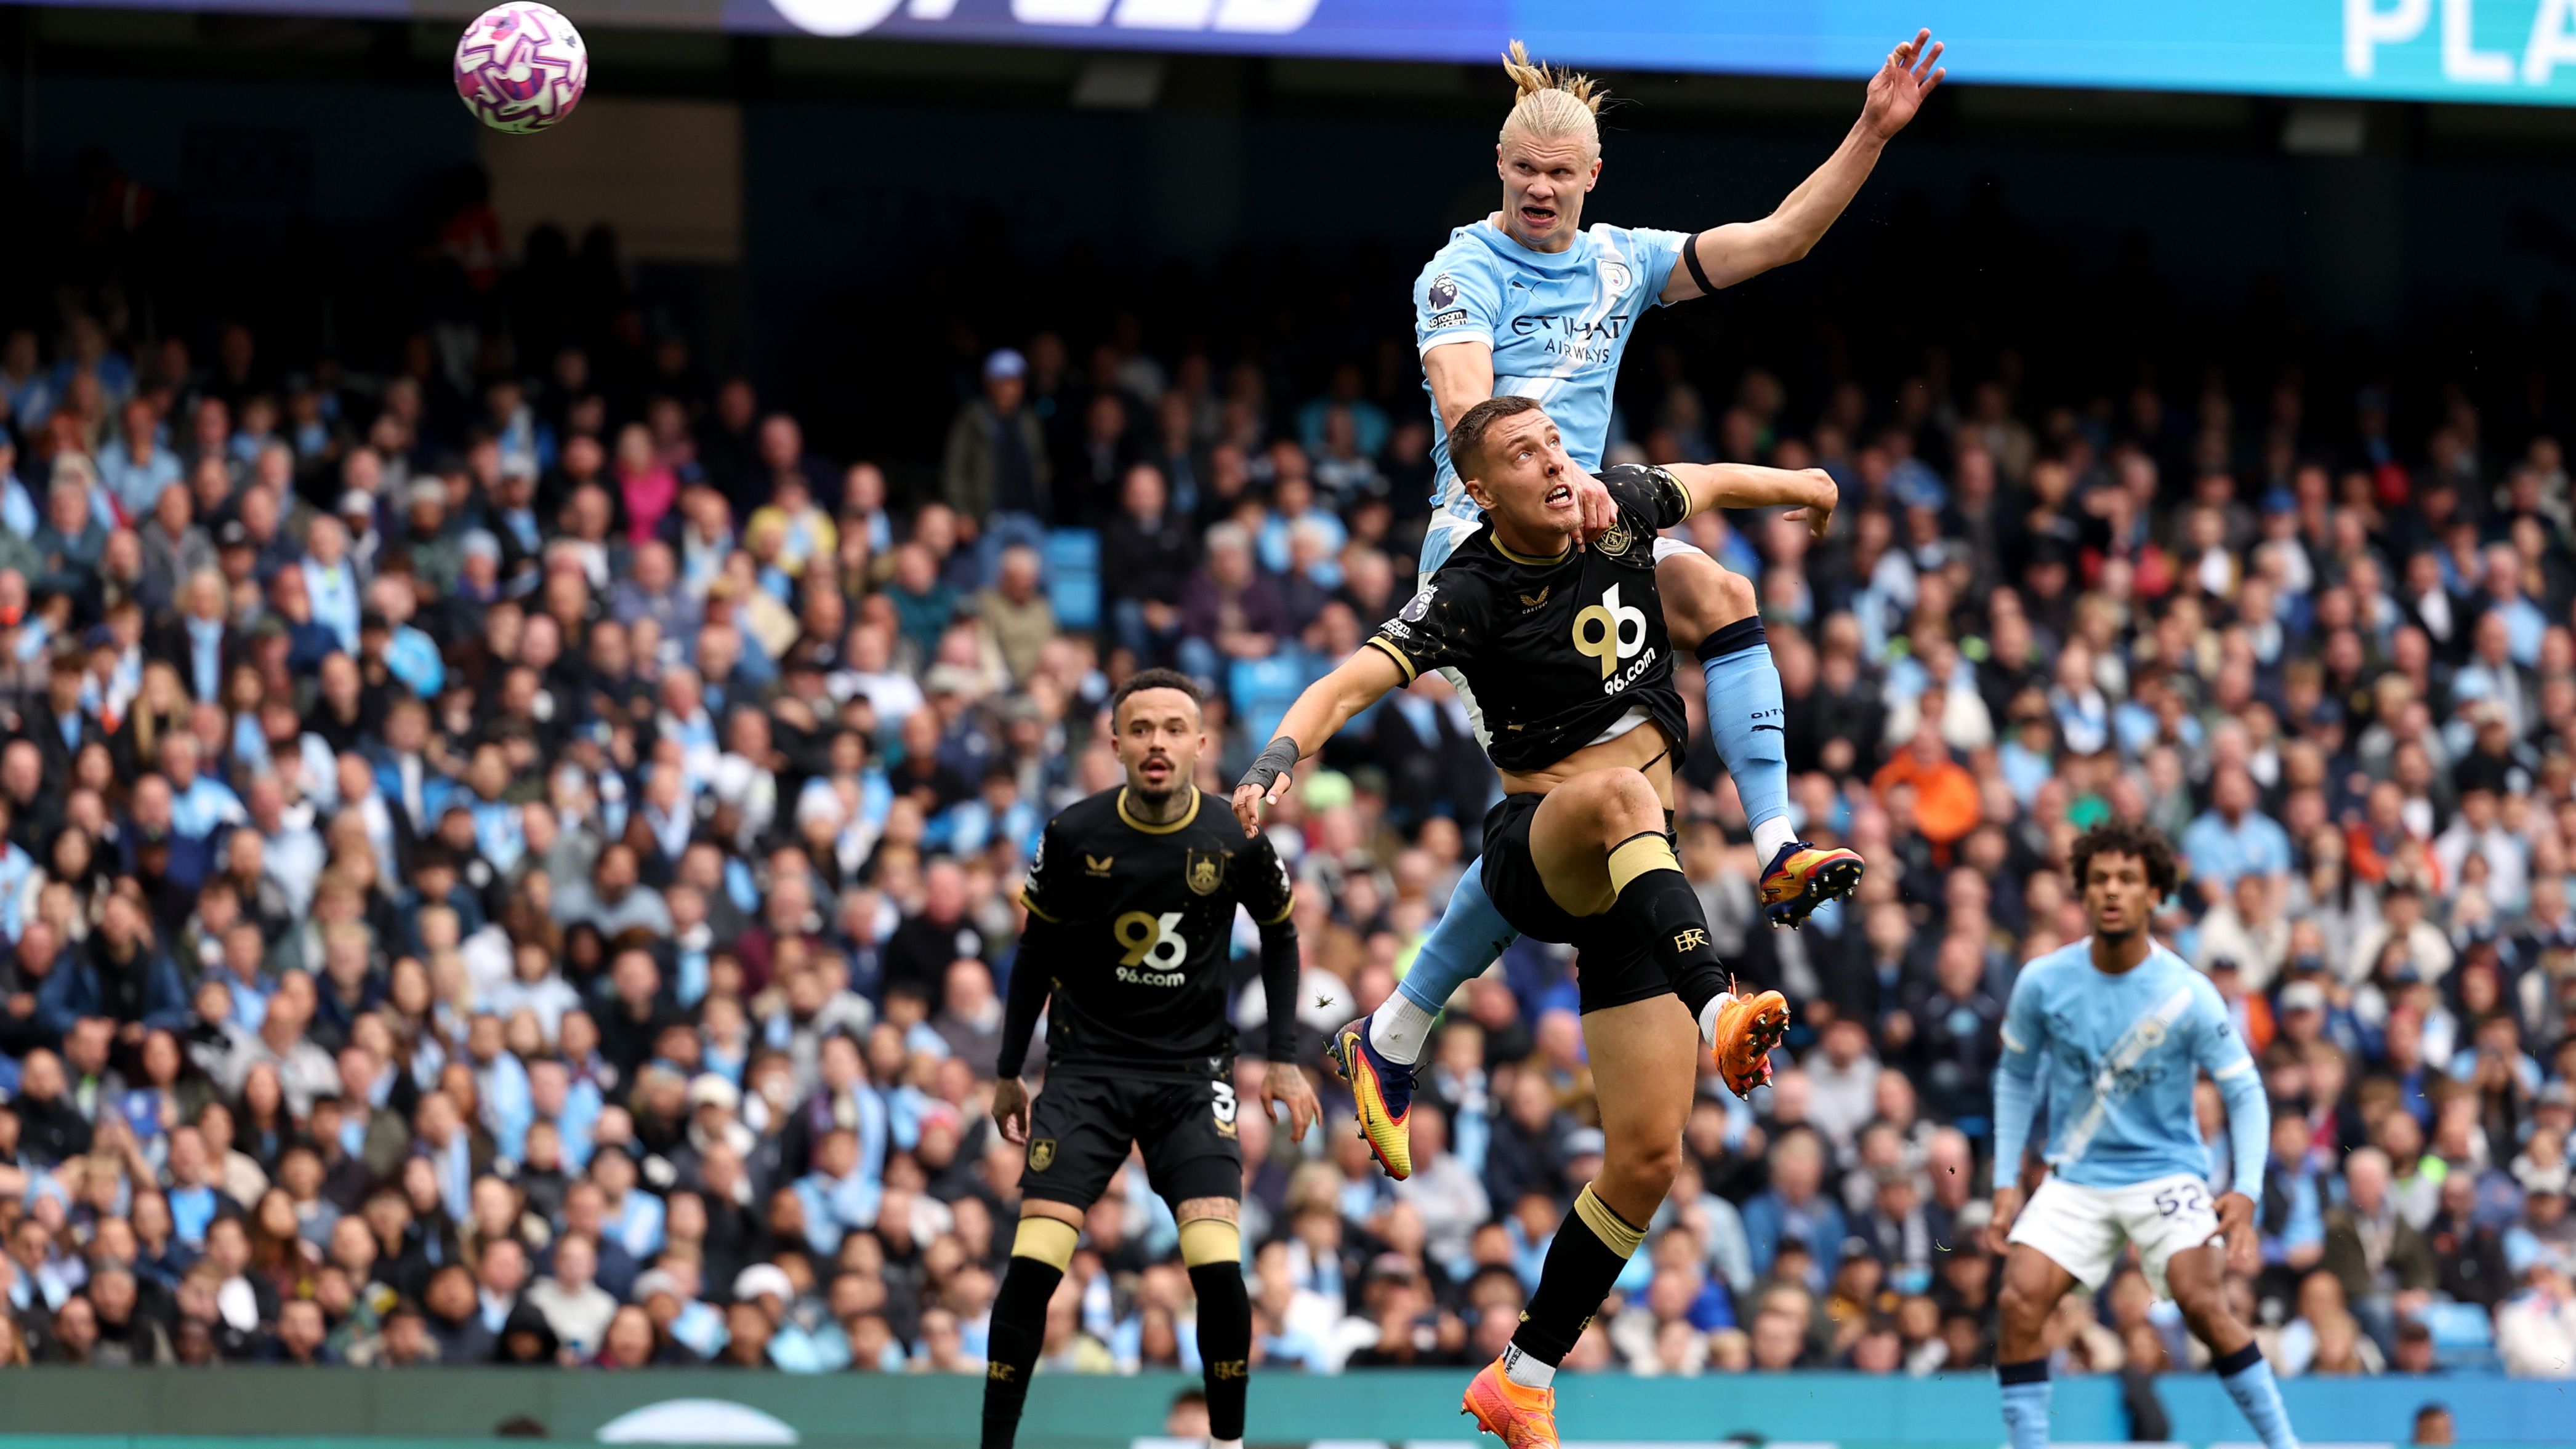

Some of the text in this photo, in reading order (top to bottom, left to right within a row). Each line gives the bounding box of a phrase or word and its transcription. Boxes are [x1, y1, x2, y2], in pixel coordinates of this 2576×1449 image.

[1438, 311, 1463, 323] room
[1544, 338, 1610, 363] AIRWAYS
[1572, 582, 1646, 680] 96
[1604, 647, 1656, 696] 96.com
[1114, 911, 1187, 970] 96
[1116, 966, 1185, 987] 96.com
[1212, 1080, 1236, 1122] 3
[2154, 1184, 2206, 1216] 52
